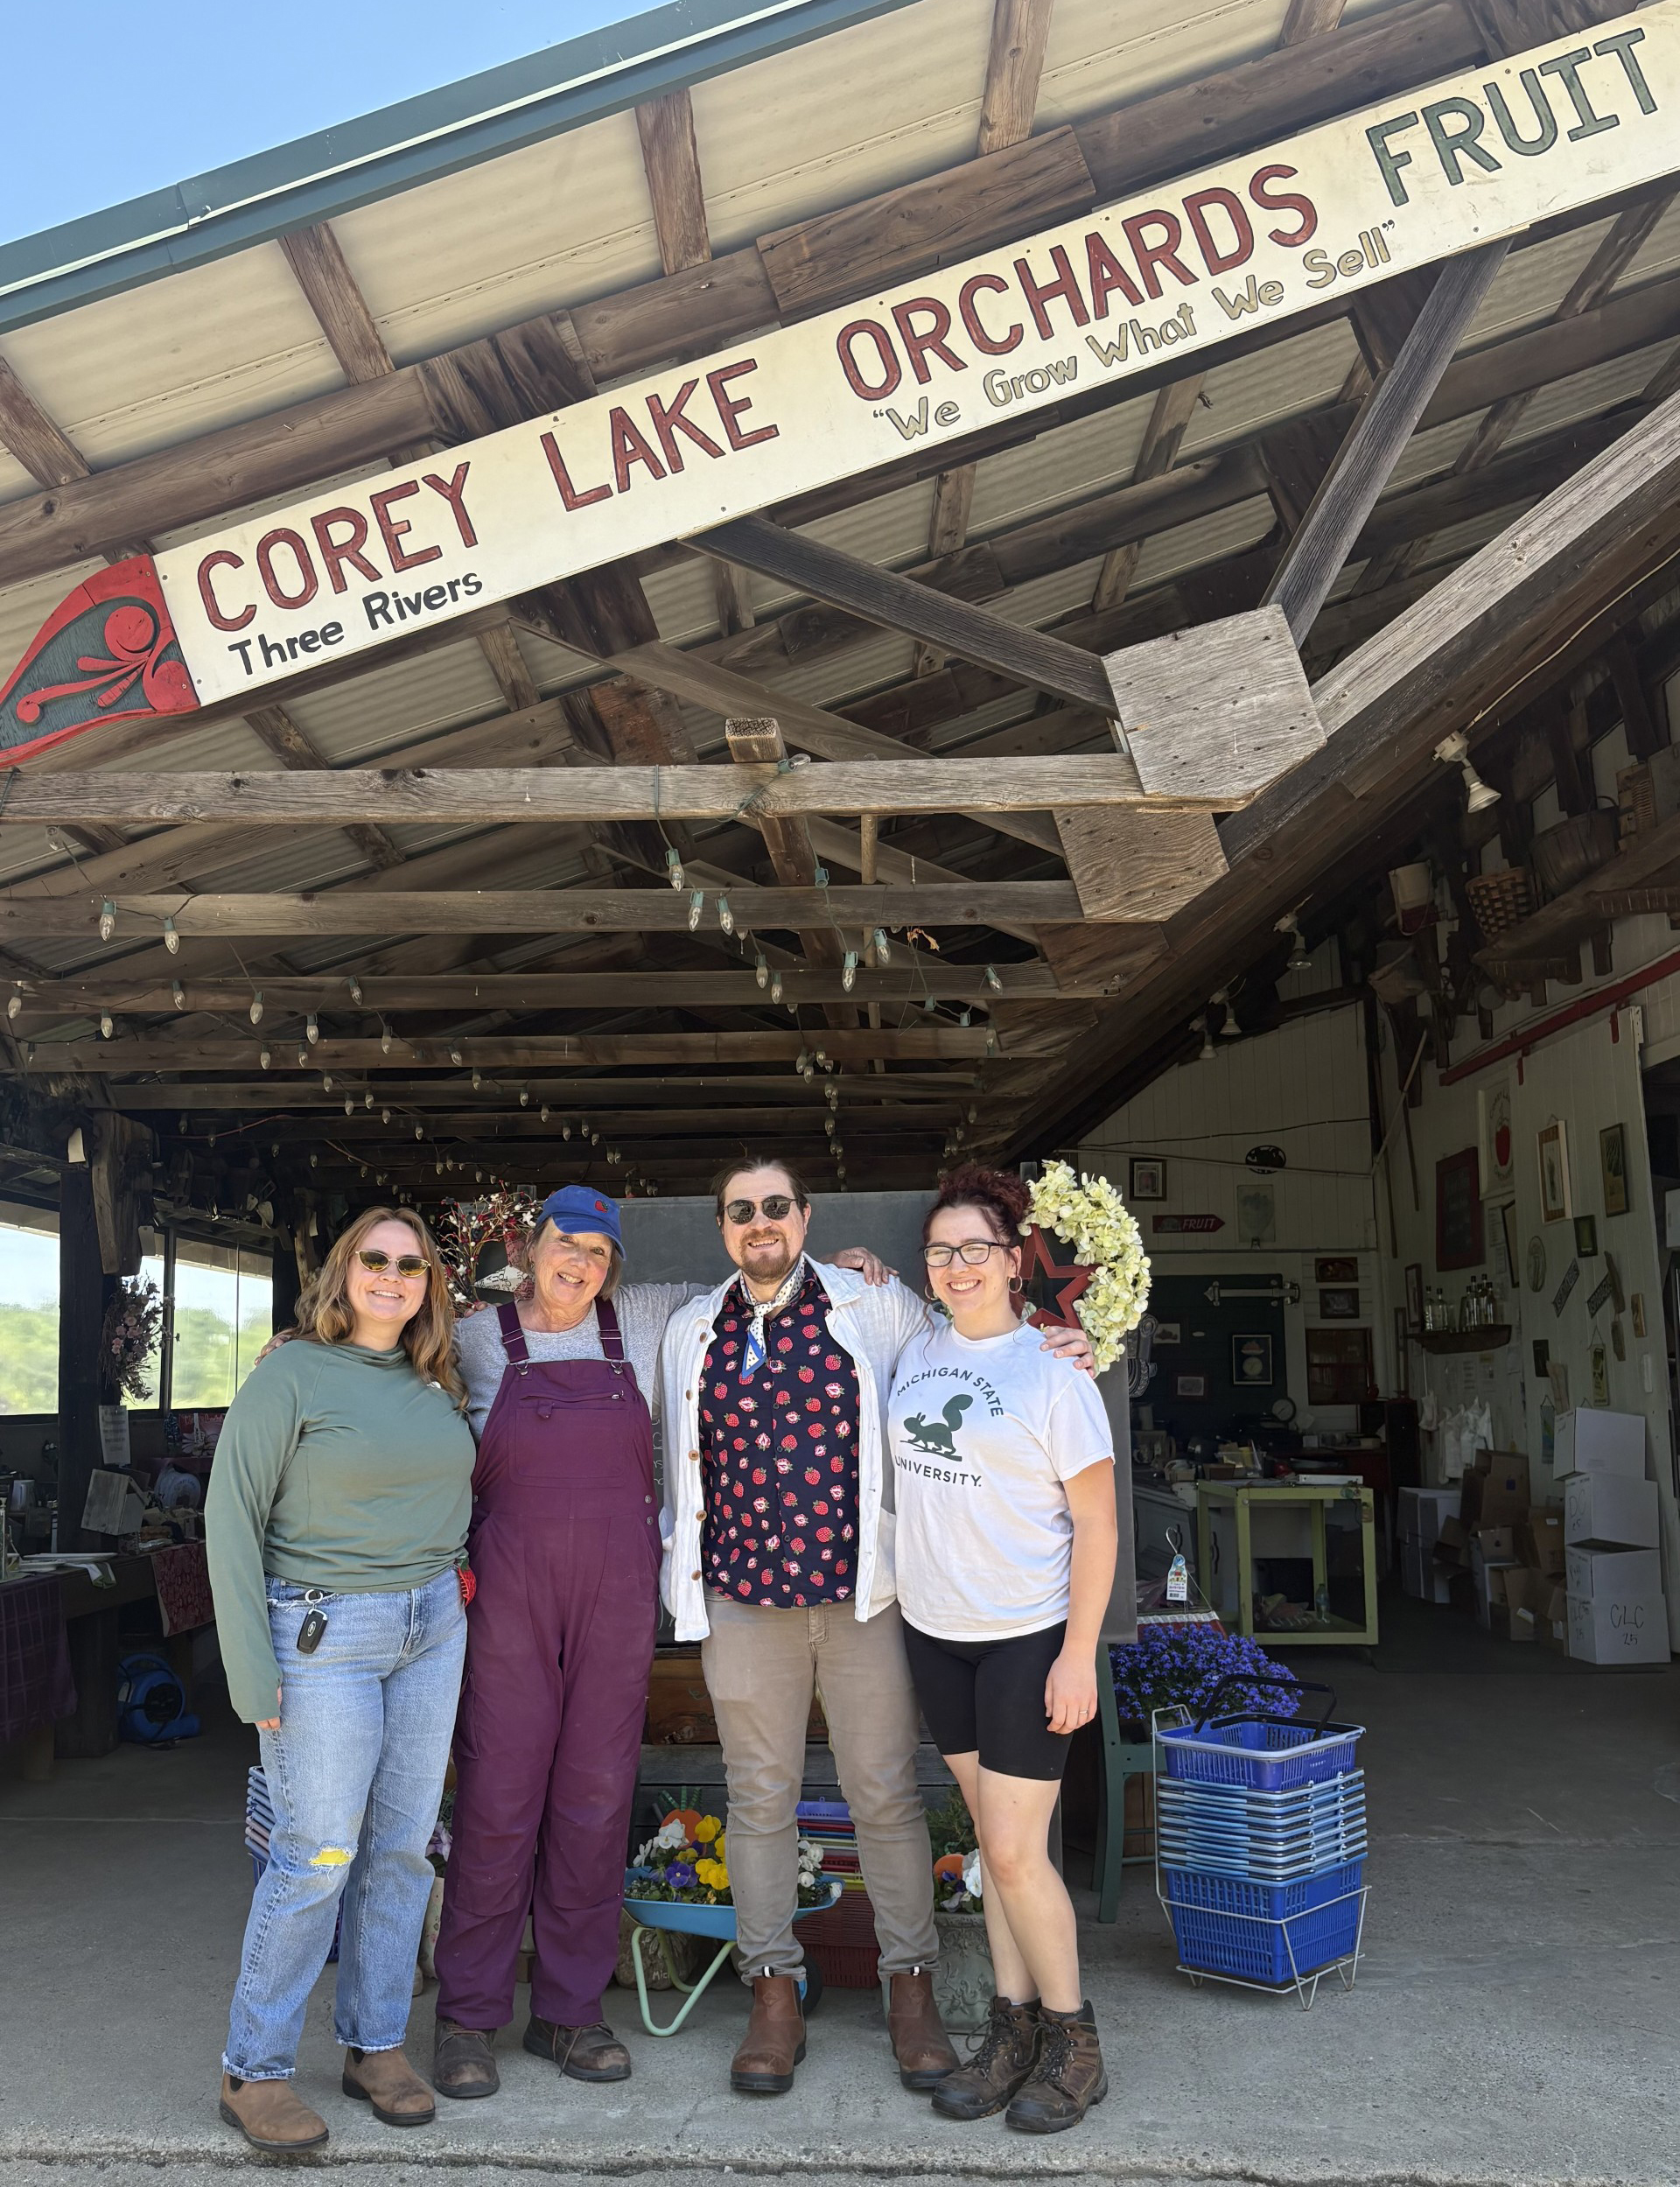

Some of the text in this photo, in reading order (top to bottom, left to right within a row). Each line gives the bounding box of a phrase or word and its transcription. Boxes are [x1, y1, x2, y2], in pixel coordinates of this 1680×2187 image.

[197, 27, 1658, 632] COREY LAKE ORCHARDS FRUIT
[983, 355, 1077, 407] Grow
[1085, 302, 1199, 368] What
[1210, 274, 1284, 321] We
[228, 571, 483, 676] Three Rivers
[1182, 1217, 1216, 1230] FRUIT
[897, 1367, 1004, 1417] MICHIGAN STATE
[1609, 1603, 1645, 1629] CLC
[1621, 1632, 1639, 1646] 25
